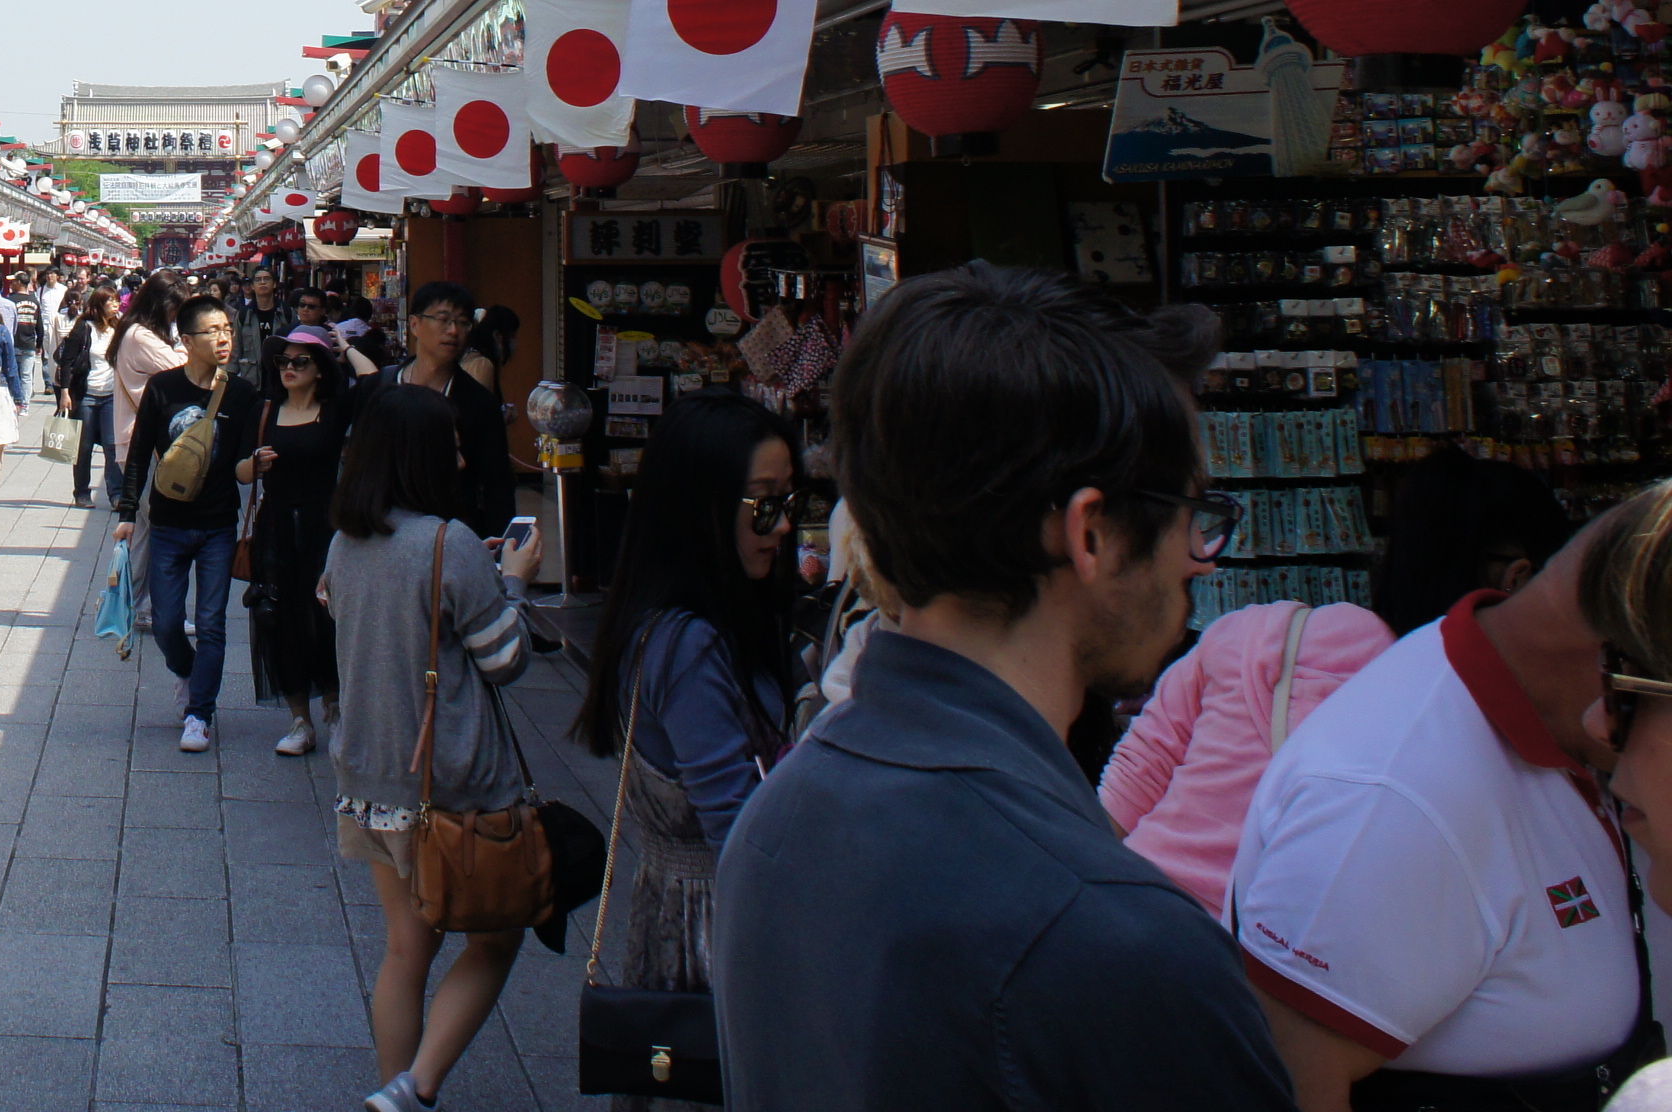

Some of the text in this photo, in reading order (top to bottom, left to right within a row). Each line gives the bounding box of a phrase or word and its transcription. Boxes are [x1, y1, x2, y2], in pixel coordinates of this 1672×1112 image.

[1128, 56, 1205, 75] 日本式雑貨
[1160, 72, 1225, 92] 福光屋
[88, 131, 213, 153] 浅草神社御祭禮
